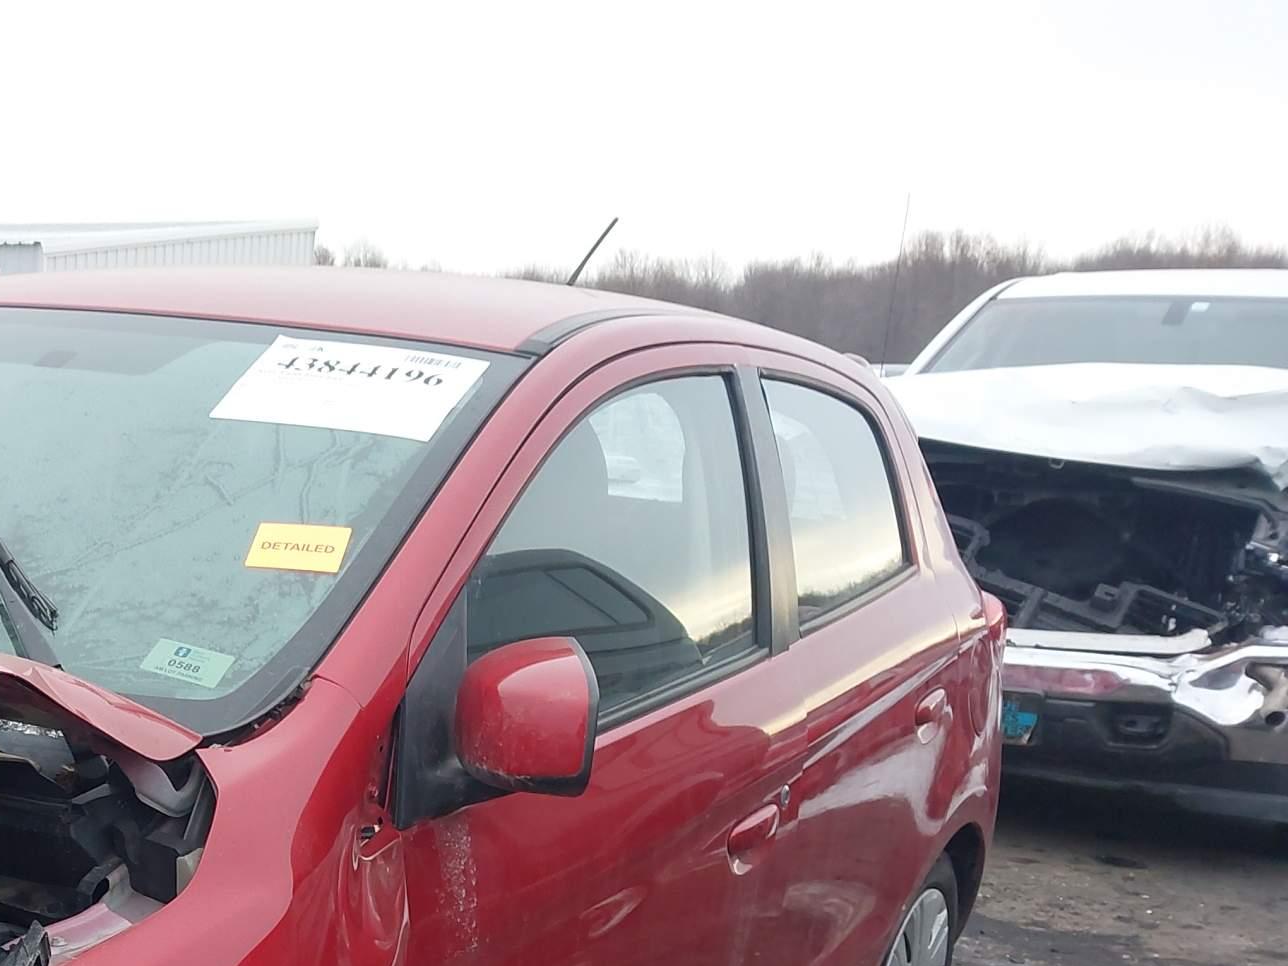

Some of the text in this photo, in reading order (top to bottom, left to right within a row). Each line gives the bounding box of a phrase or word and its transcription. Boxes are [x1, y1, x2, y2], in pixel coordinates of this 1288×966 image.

[277, 356, 444, 387] 43844196
[260, 540, 336, 554] DETAILED
[167, 658, 201, 673] 0588
